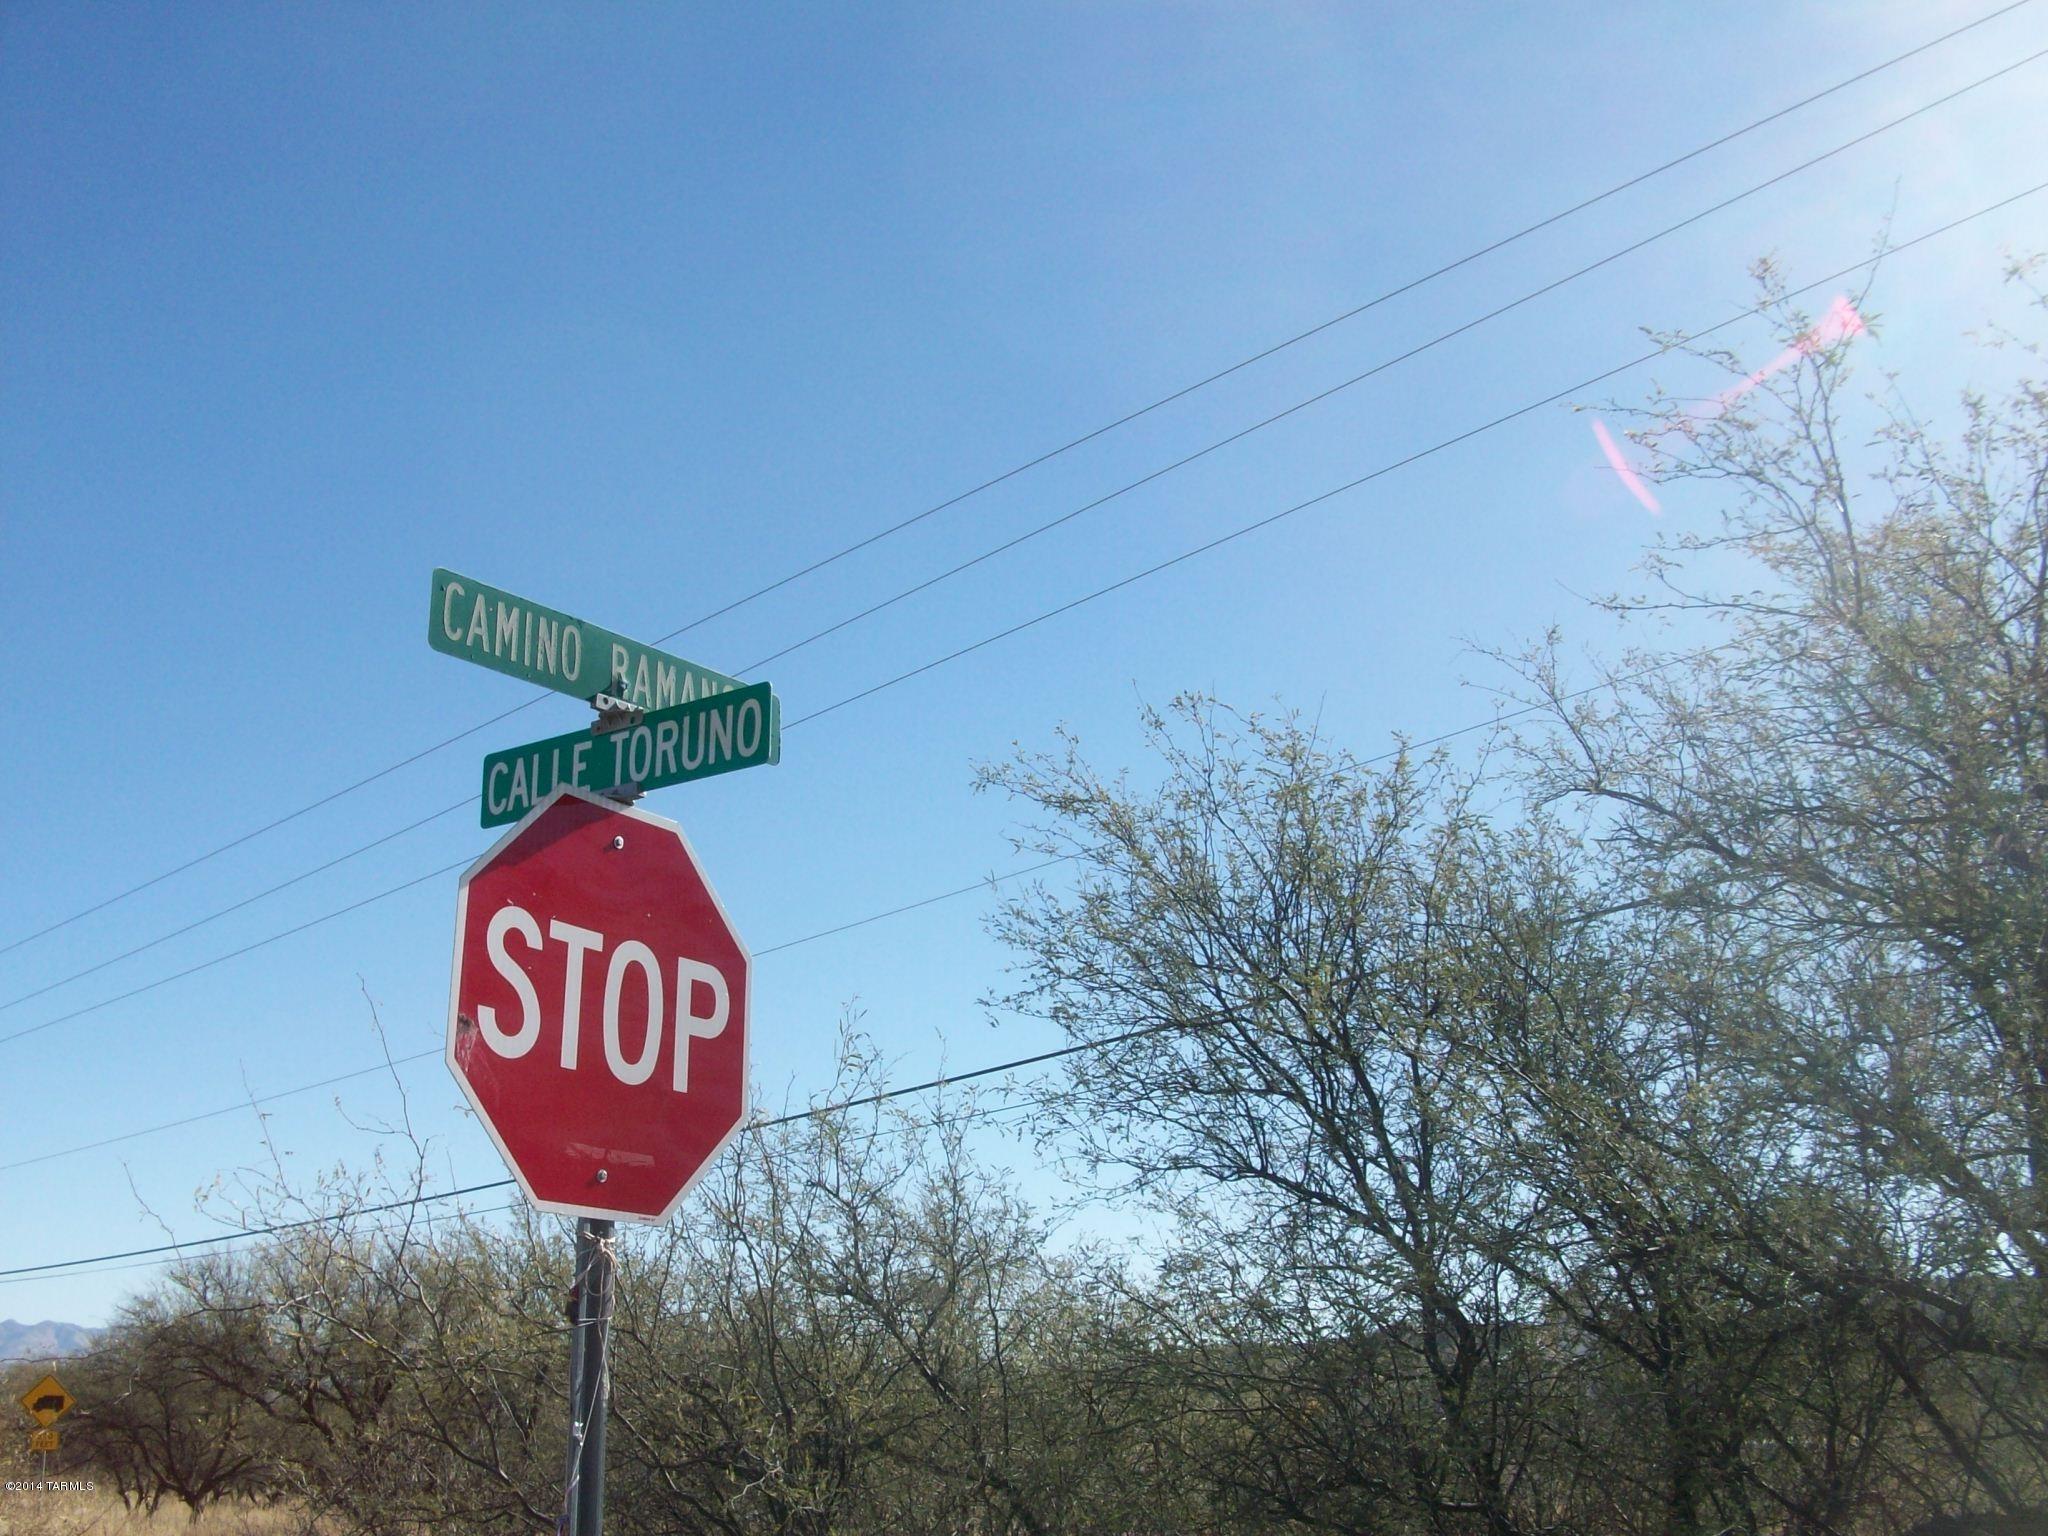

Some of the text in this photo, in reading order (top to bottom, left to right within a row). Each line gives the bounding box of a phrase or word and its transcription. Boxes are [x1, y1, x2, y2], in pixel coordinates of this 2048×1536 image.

[443, 582, 736, 711] CAMINO RAMA
[488, 698, 763, 816] CALLE TORUNO
[477, 906, 730, 1093] STOP
